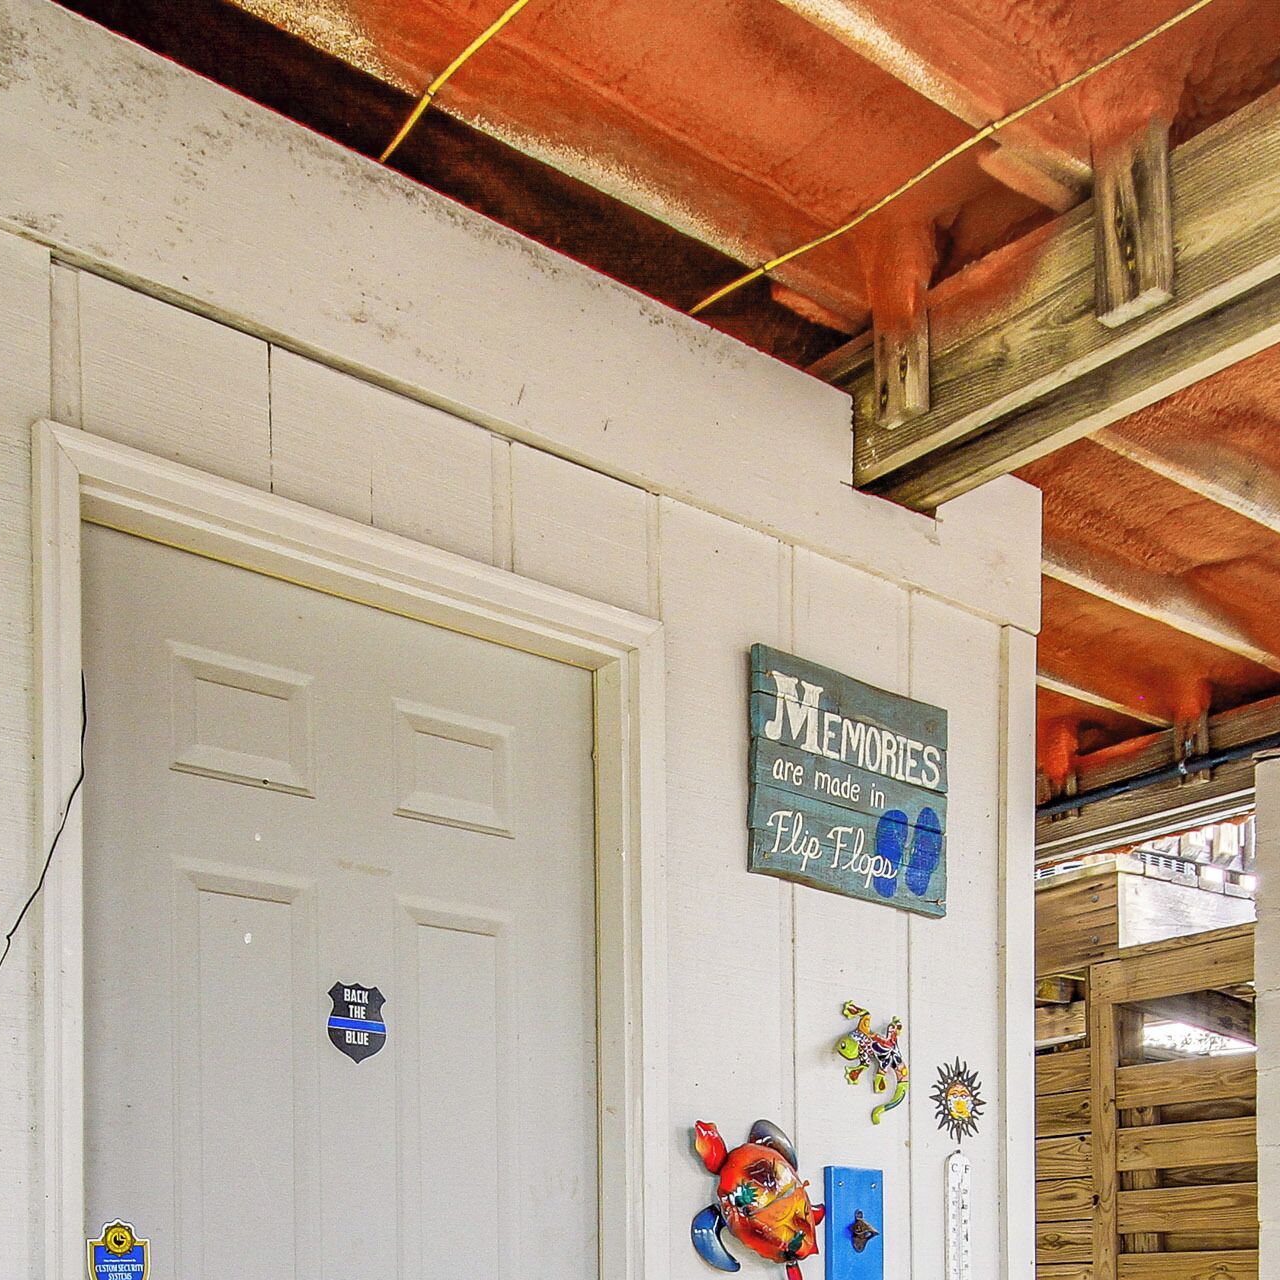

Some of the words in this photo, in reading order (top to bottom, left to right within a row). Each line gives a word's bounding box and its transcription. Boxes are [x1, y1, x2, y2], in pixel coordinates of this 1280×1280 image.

[764, 670, 941, 789] MEMORIES
[772, 758, 804, 786] are
[814, 770, 860, 802] made
[870, 783, 885, 809] in
[766, 811, 822, 871] Flip
[827, 826, 897, 888] Flops
[343, 988, 369, 1004] BACK
[348, 1004, 367, 1019] THE
[345, 1030, 369, 1046] BLUE
